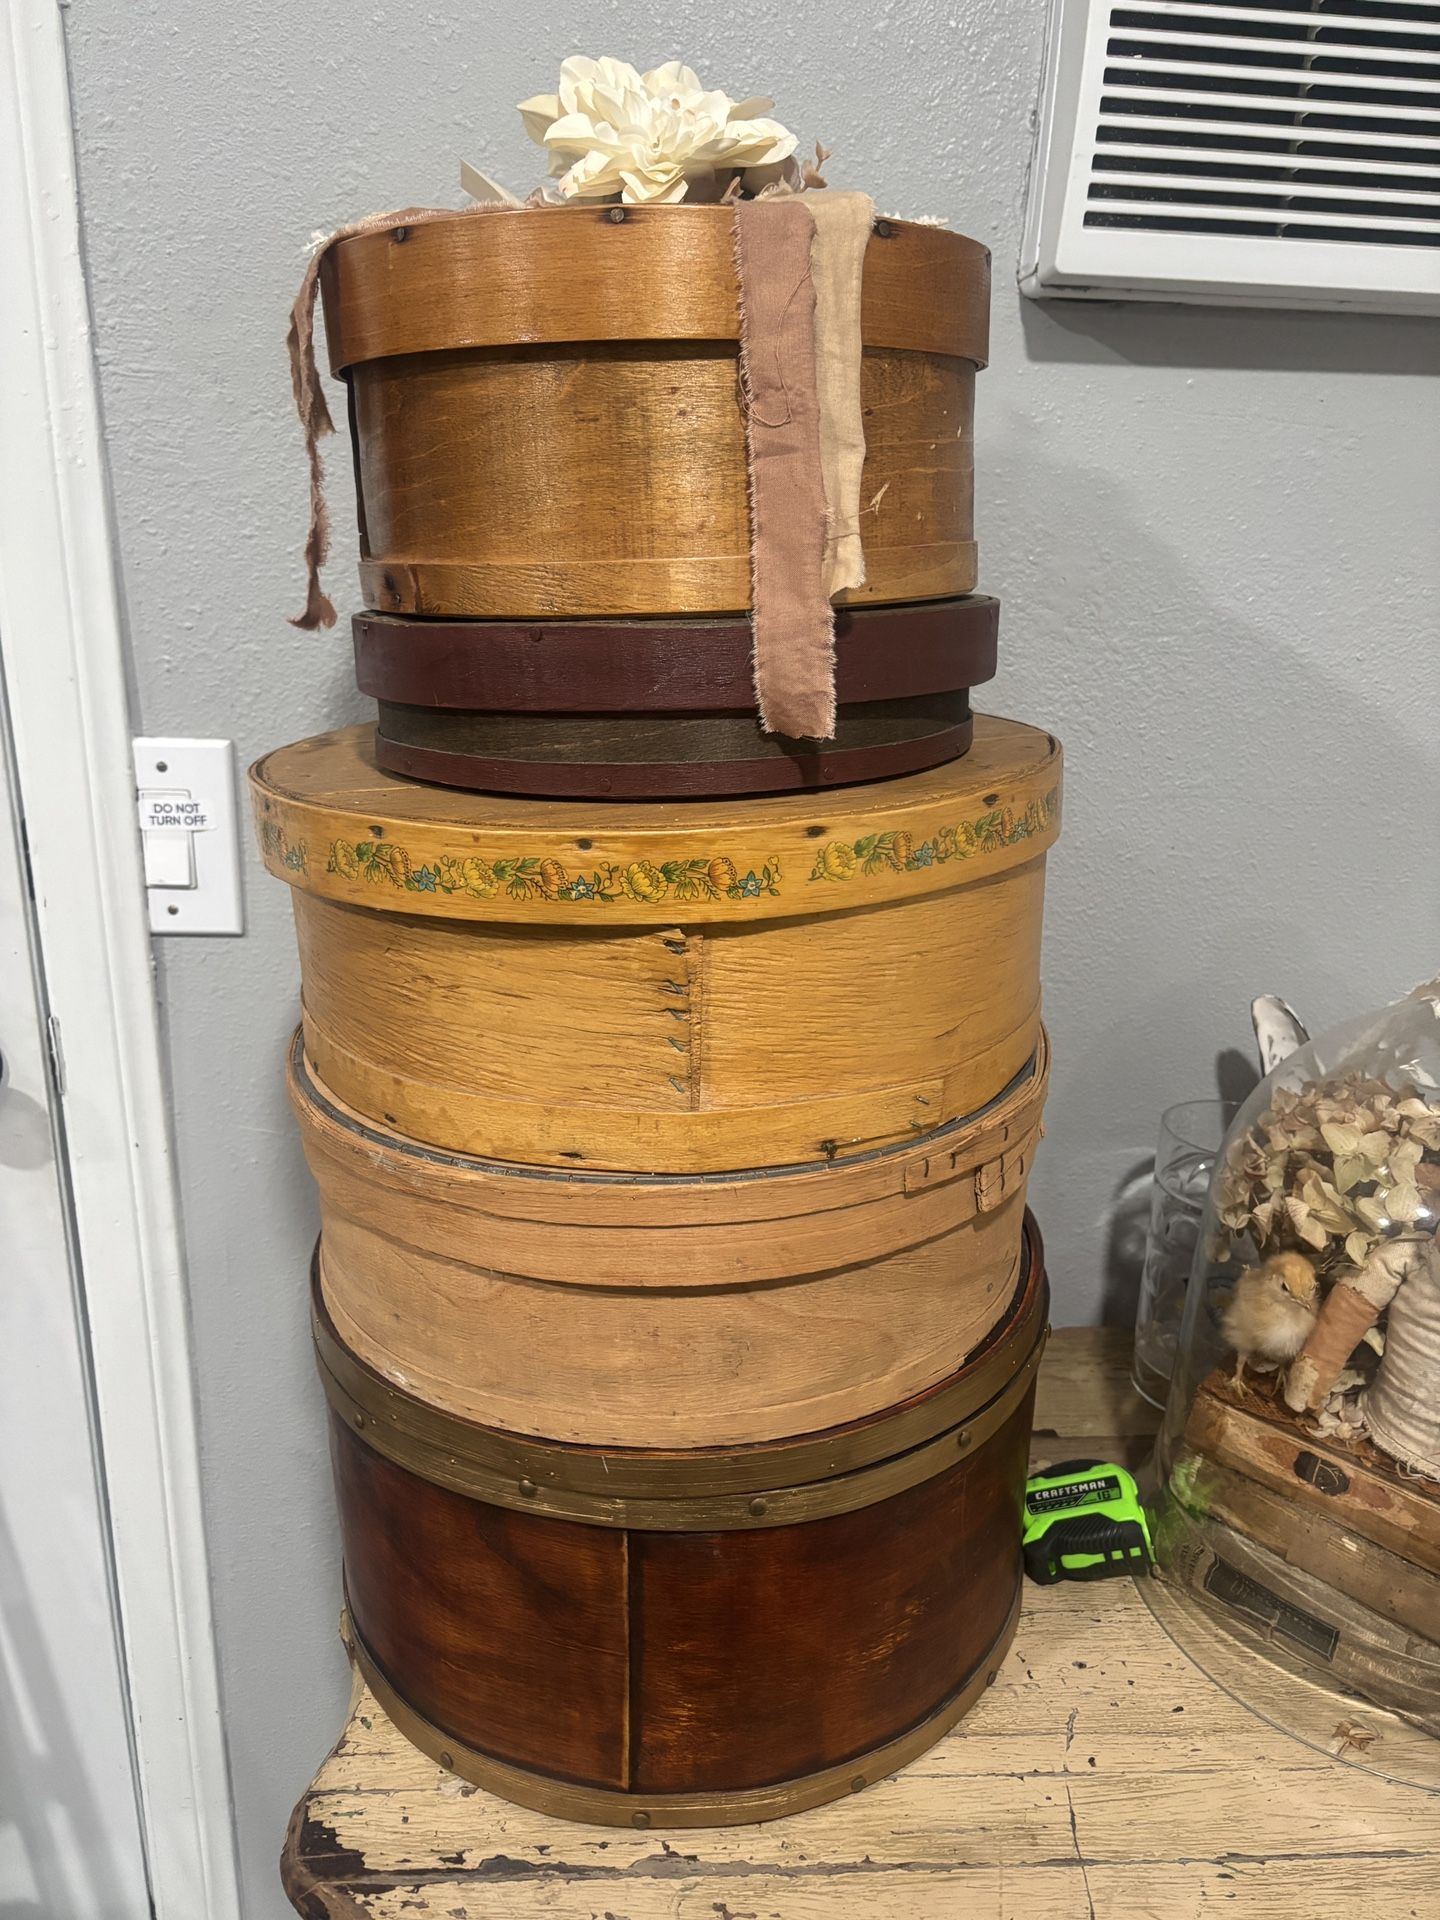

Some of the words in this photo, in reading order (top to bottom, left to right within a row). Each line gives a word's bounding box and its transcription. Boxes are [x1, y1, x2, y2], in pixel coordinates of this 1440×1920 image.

[153, 803, 173, 814] DO
[175, 803, 200, 814] NOT
[149, 815, 181, 826] TURN
[184, 815, 208, 826] OFF
[1034, 1479, 1106, 1500] CRAFTSMAN
